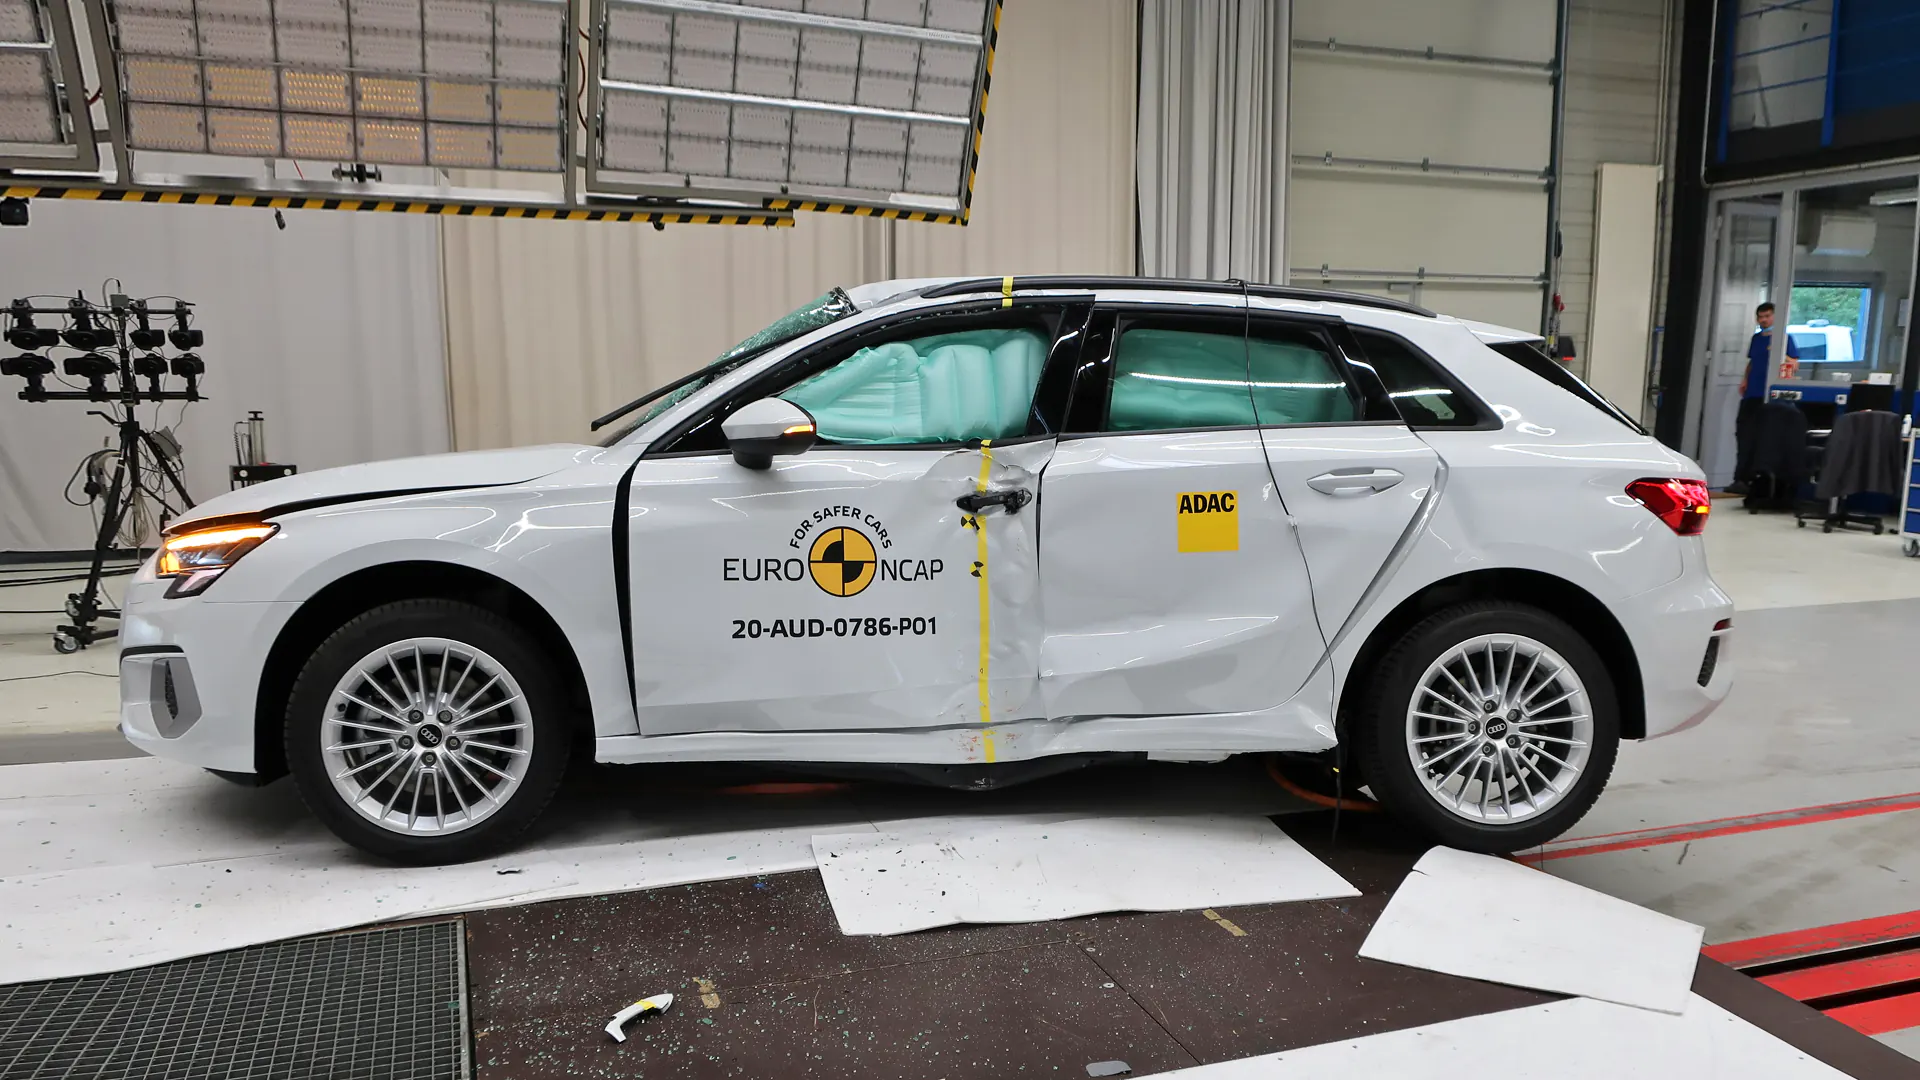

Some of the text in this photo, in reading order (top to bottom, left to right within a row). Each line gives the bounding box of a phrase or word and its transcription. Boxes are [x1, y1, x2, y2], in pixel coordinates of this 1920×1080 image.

[1179, 492, 1235, 514] ADAC
[789, 505, 893, 549] FOR SAFER CARS
[723, 558, 944, 582] EURO NCAP
[731, 616, 936, 639] 20-AUD-0786-P01
